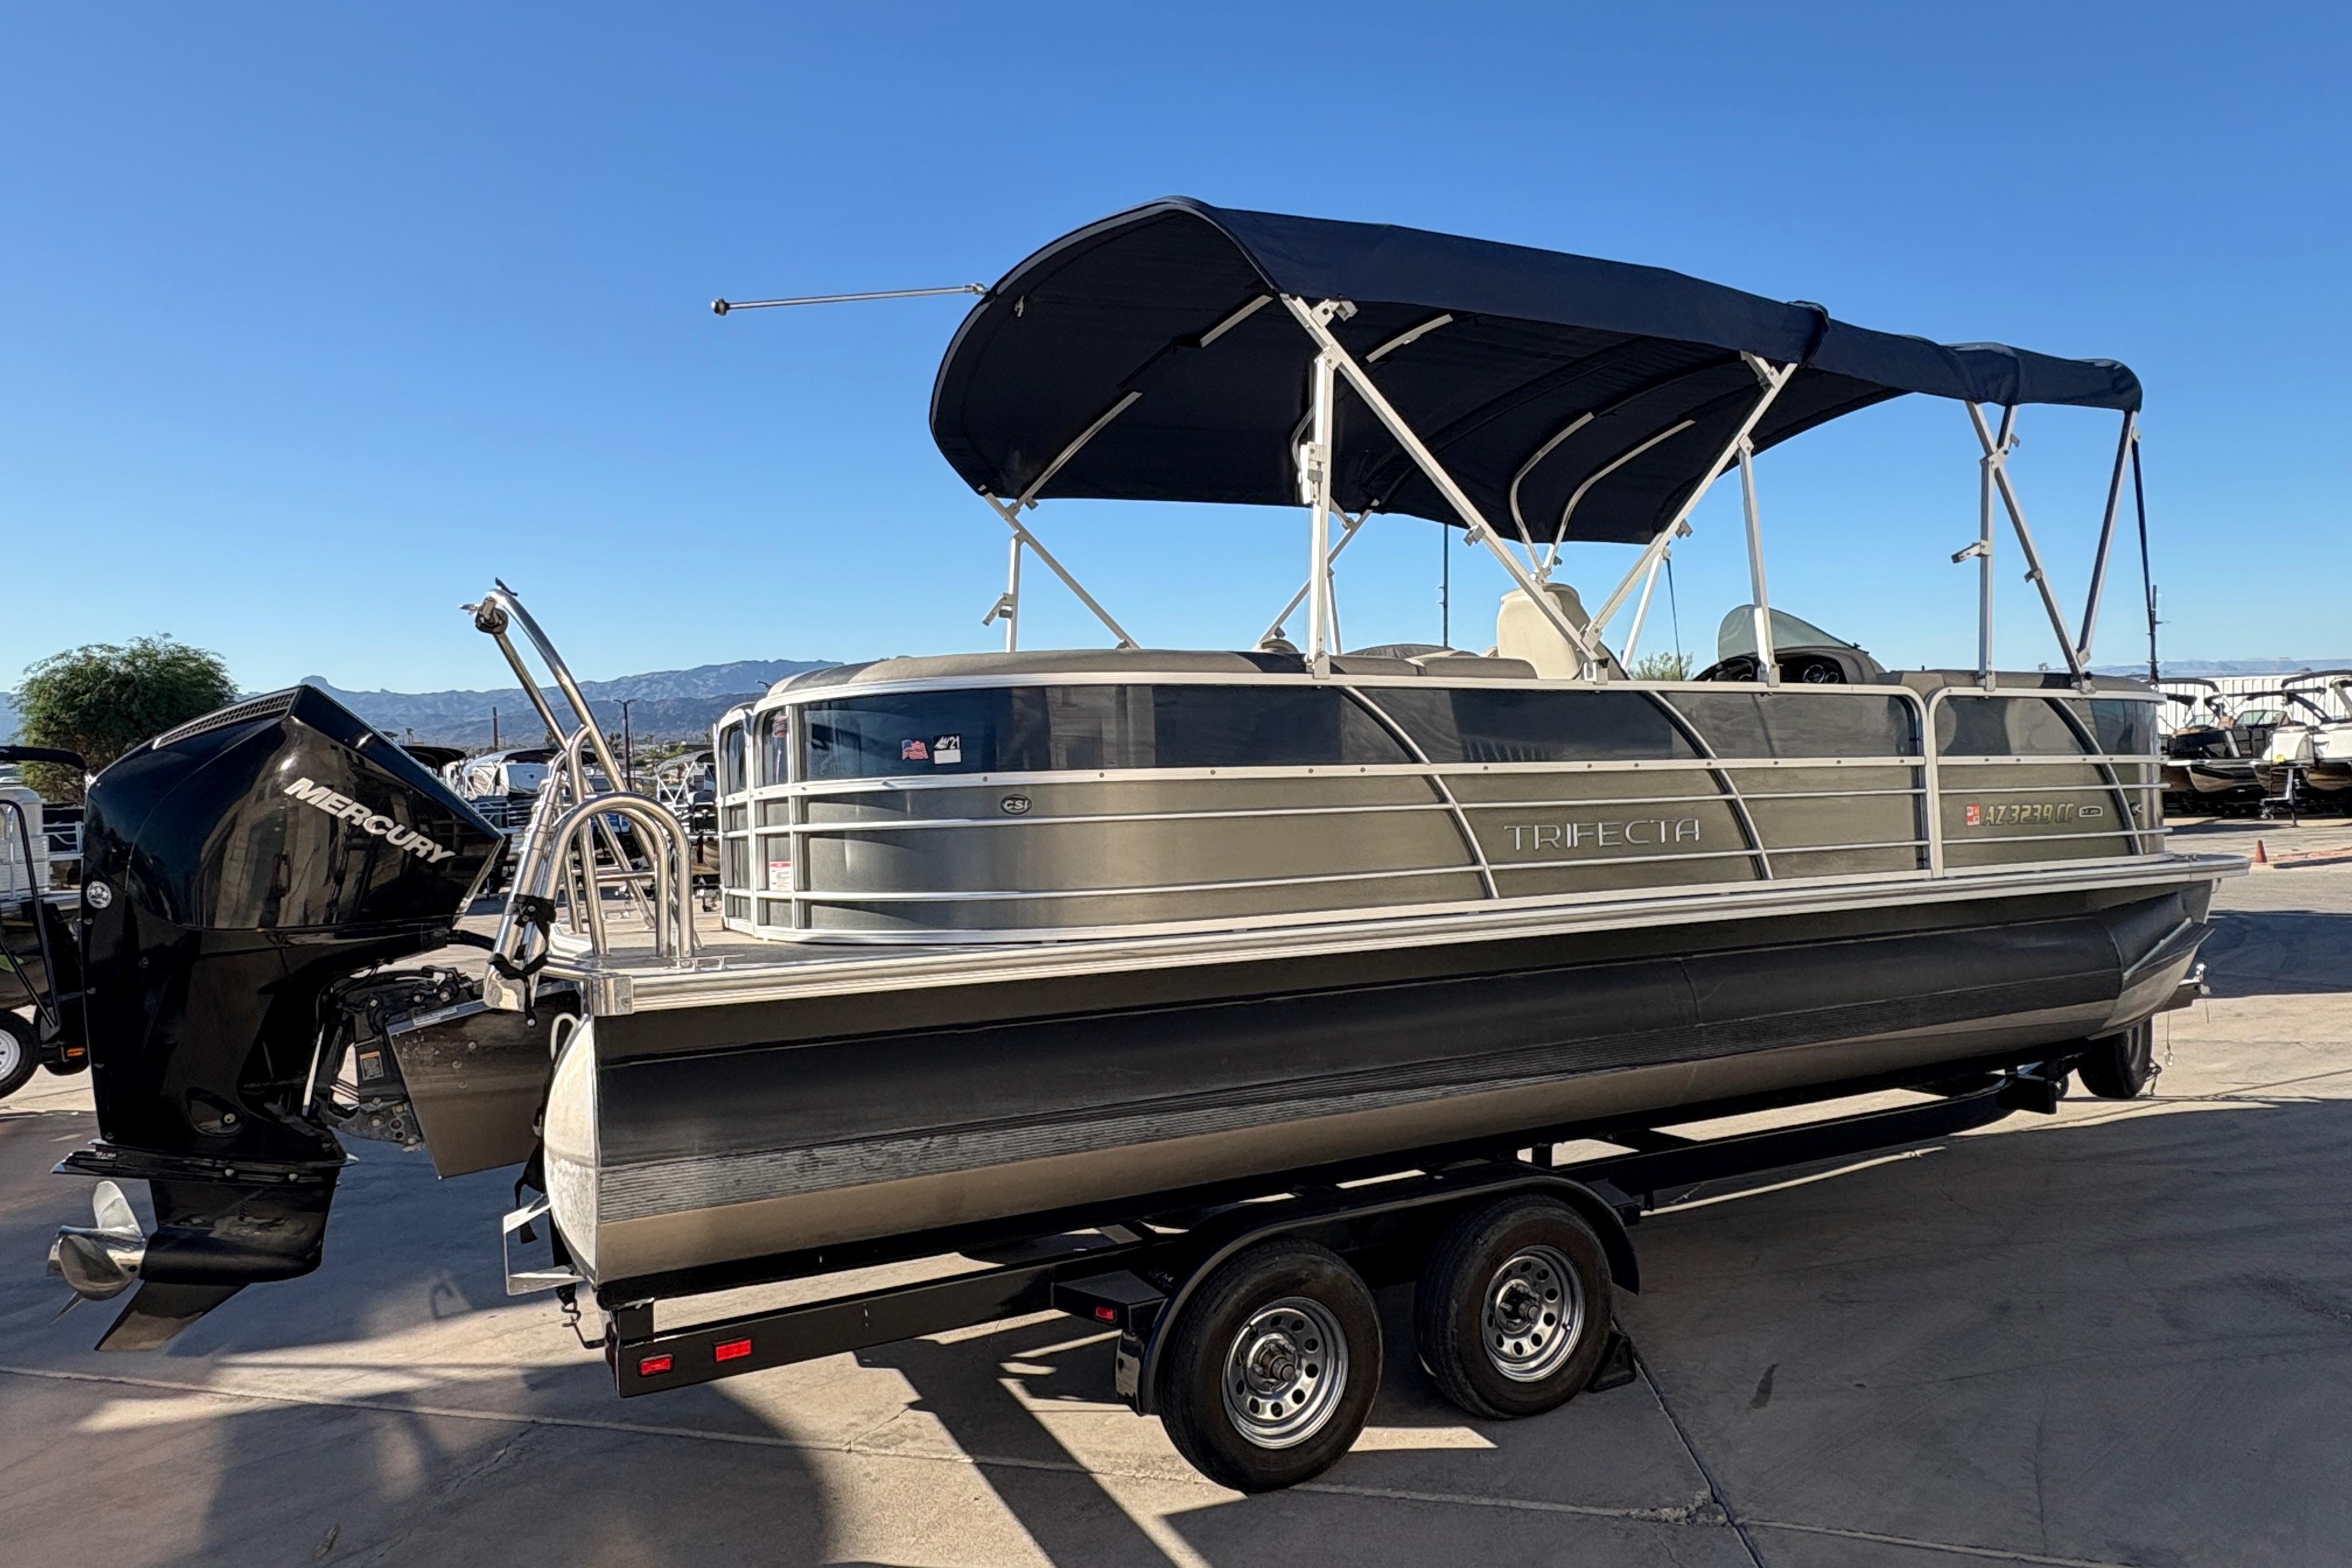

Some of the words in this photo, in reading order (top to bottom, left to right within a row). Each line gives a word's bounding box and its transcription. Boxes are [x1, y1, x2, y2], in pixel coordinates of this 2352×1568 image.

[284, 777, 456, 864] MERCURY
[1983, 805, 2007, 826] AZ
[1503, 818, 1700, 851] TRIFECTA
